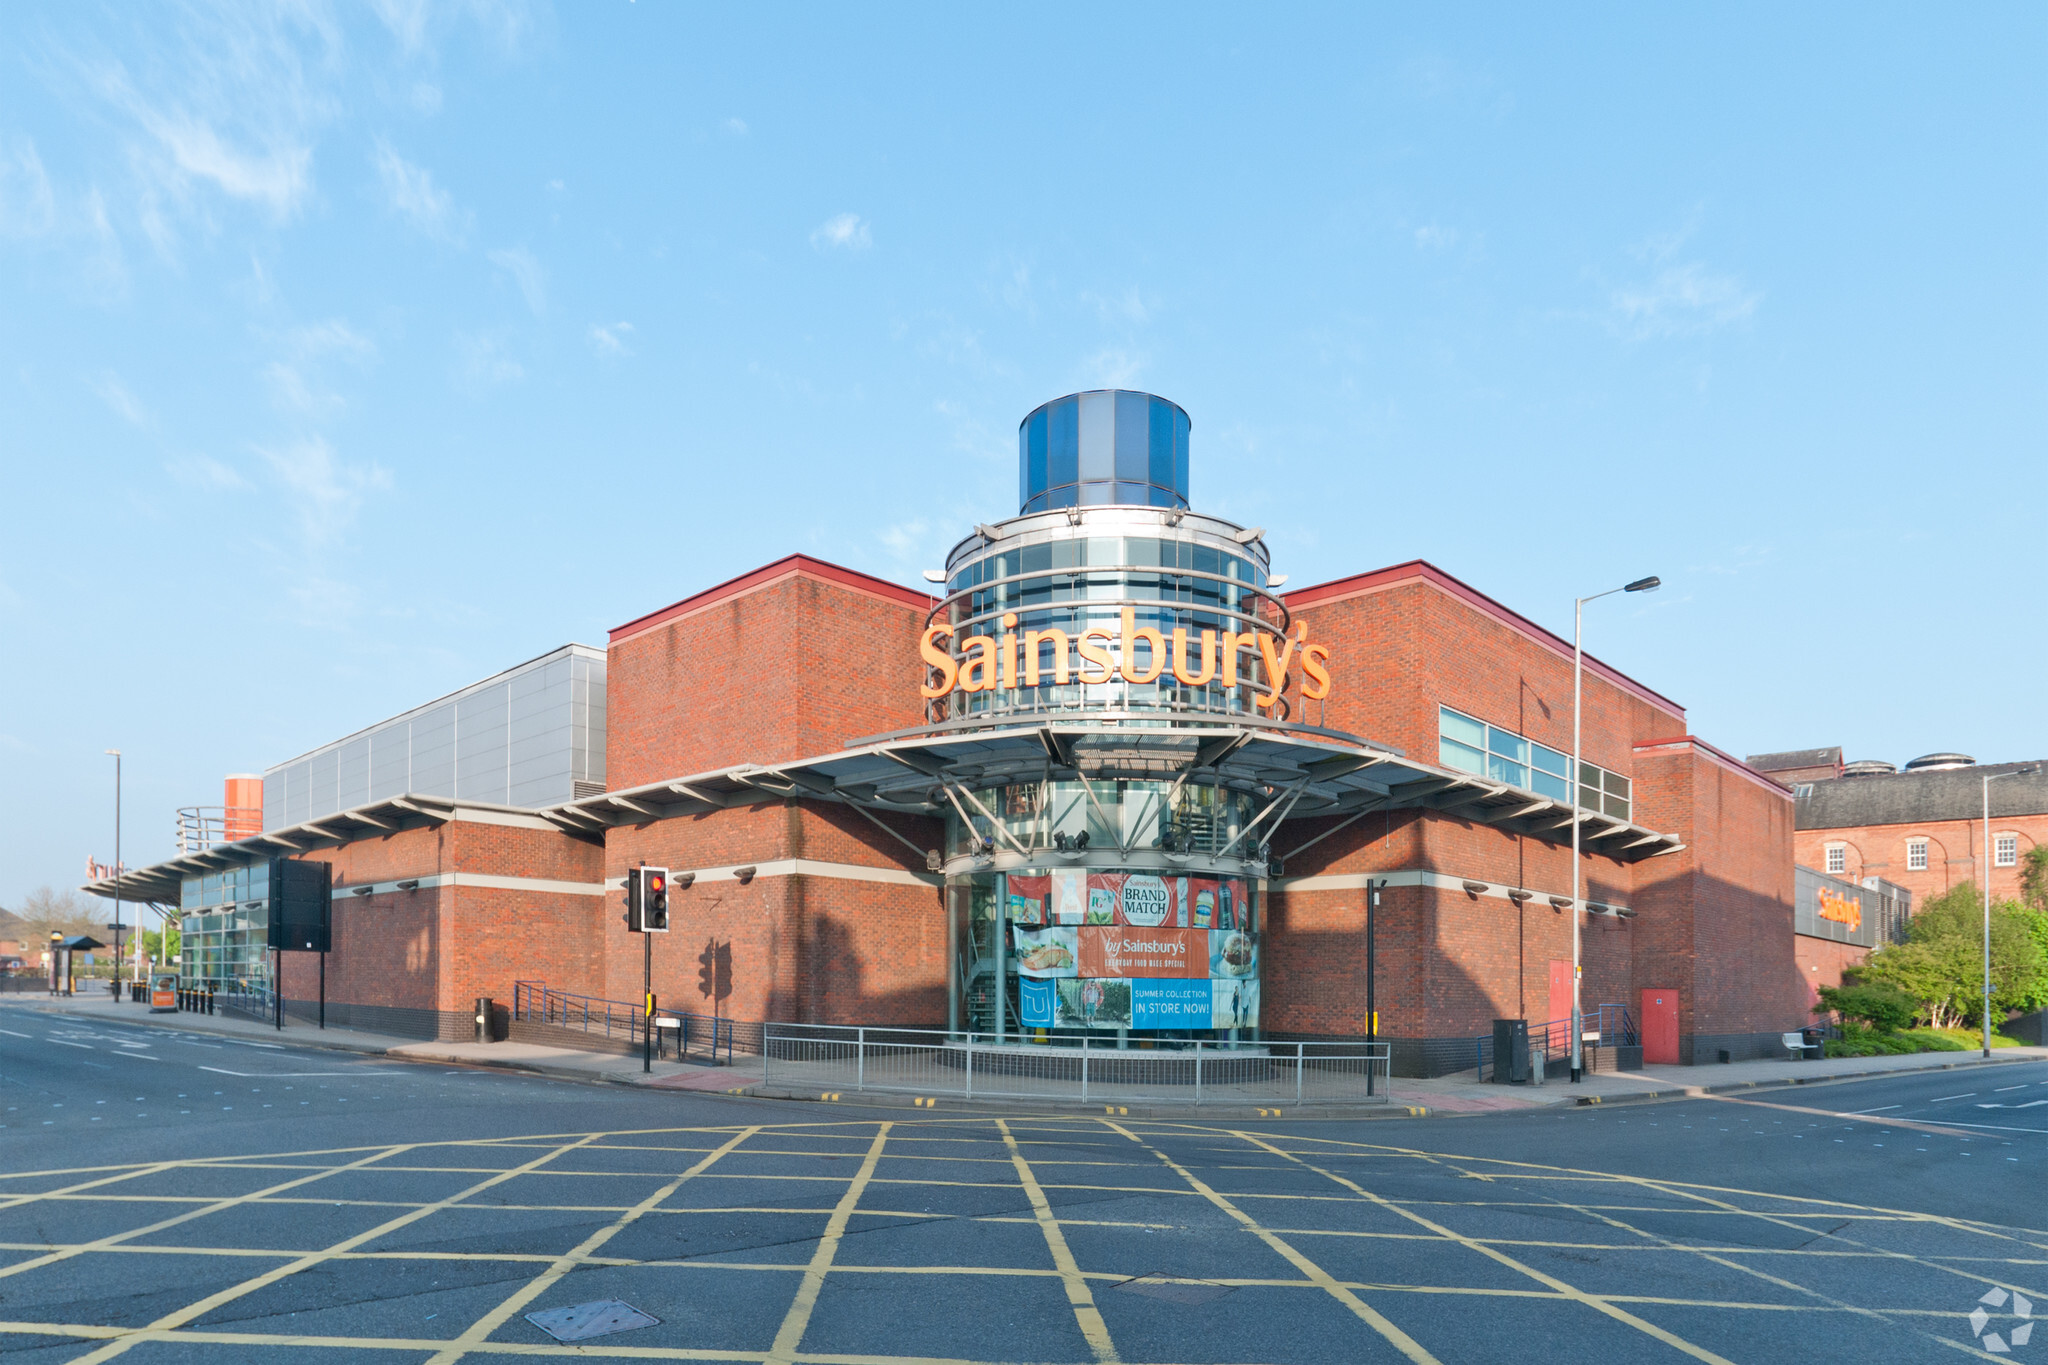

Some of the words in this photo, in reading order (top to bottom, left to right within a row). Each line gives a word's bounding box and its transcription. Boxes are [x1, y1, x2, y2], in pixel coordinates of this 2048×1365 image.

[919, 607, 1331, 708] Sainsbury's
[1124, 887, 1166, 901] BRAND
[1124, 901, 1166, 915] MATCH
[1105, 937, 1121, 957] by
[1123, 939, 1186, 956] Sainsbury's
[1135, 990, 1164, 998] SUMMER
[1165, 990, 1208, 998] COLLECTION
[1024, 994, 1045, 1013] TU
[1135, 1003, 1146, 1014] IN
[1148, 1003, 1180, 1014] STORE
[1183, 1003, 1210, 1014] NOW!
